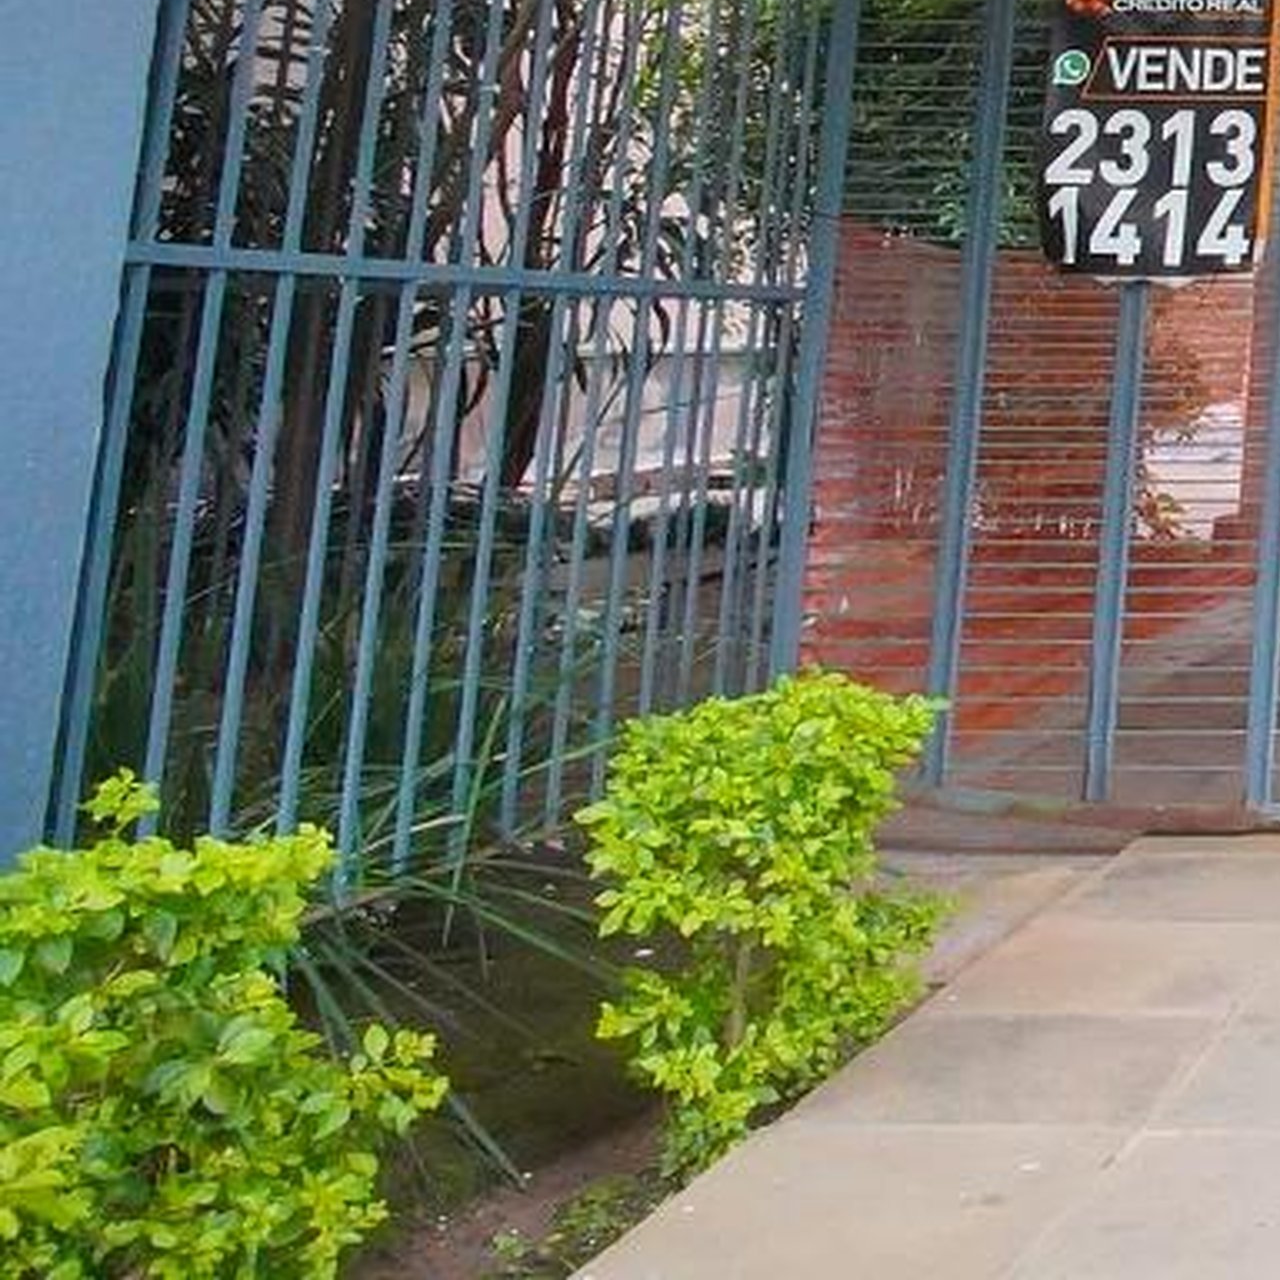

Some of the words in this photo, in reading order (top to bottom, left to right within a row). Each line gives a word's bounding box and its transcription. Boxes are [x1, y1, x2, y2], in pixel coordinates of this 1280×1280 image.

[1107, 46, 1266, 92] VENDE
[1045, 108, 1258, 187] 2313
[1048, 186, 1251, 267] 1414
